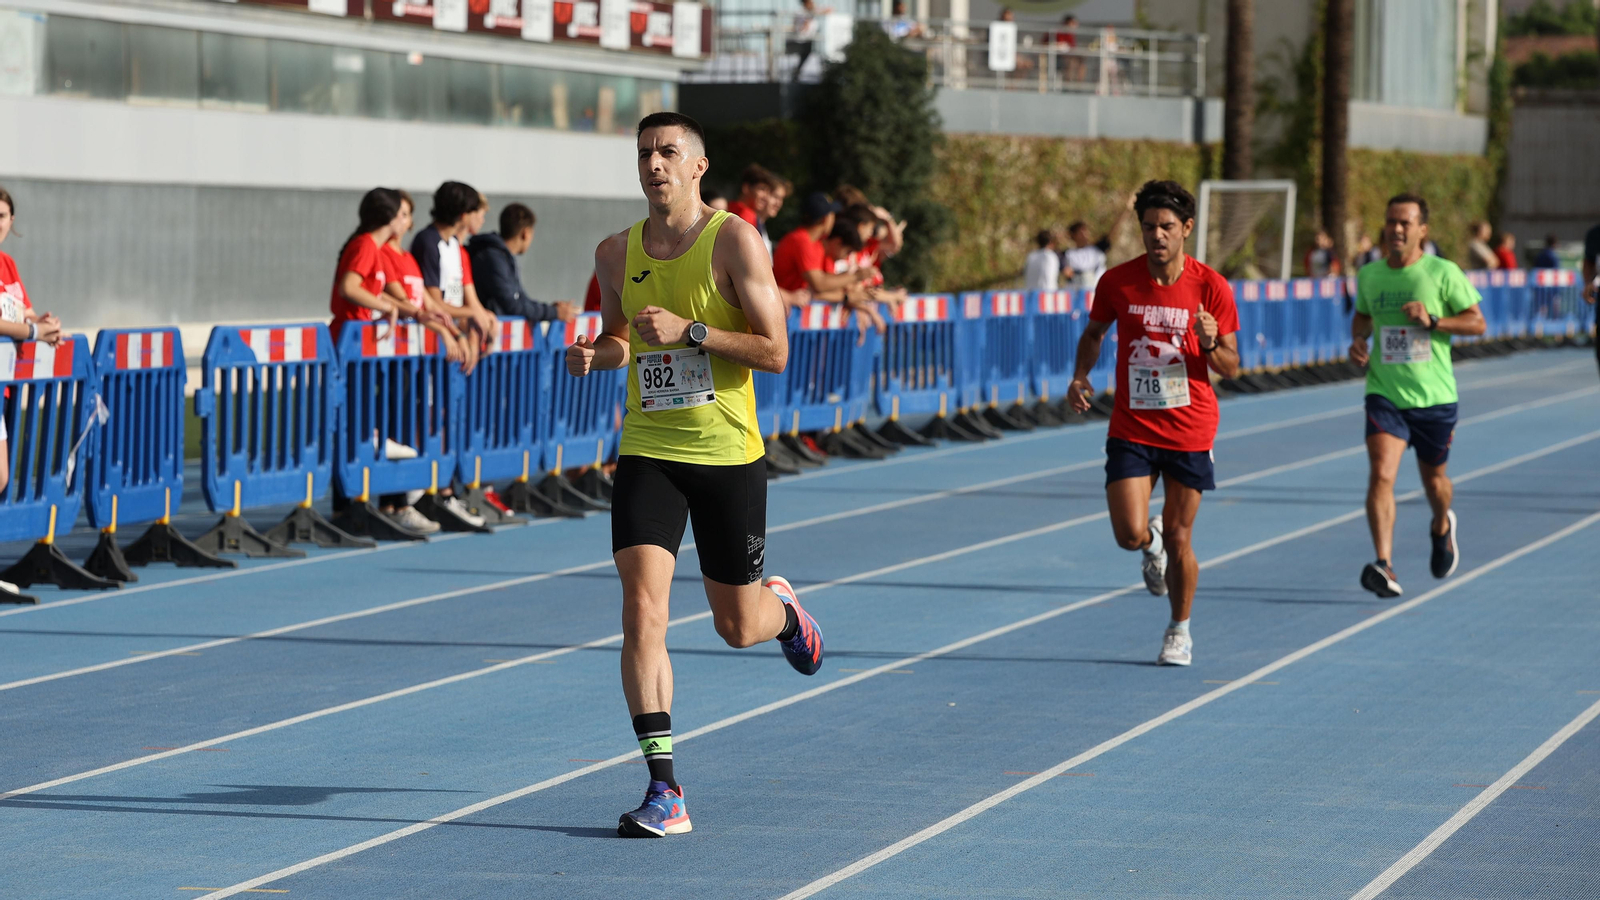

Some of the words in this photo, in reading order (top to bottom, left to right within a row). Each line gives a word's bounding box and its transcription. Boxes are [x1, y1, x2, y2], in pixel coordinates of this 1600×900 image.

[1145, 305, 1189, 320] CARRERA
[1143, 315, 1188, 329] POPULAR
[1386, 336, 1407, 350] 806
[643, 366, 675, 389] 982
[1135, 378, 1161, 394] 718
